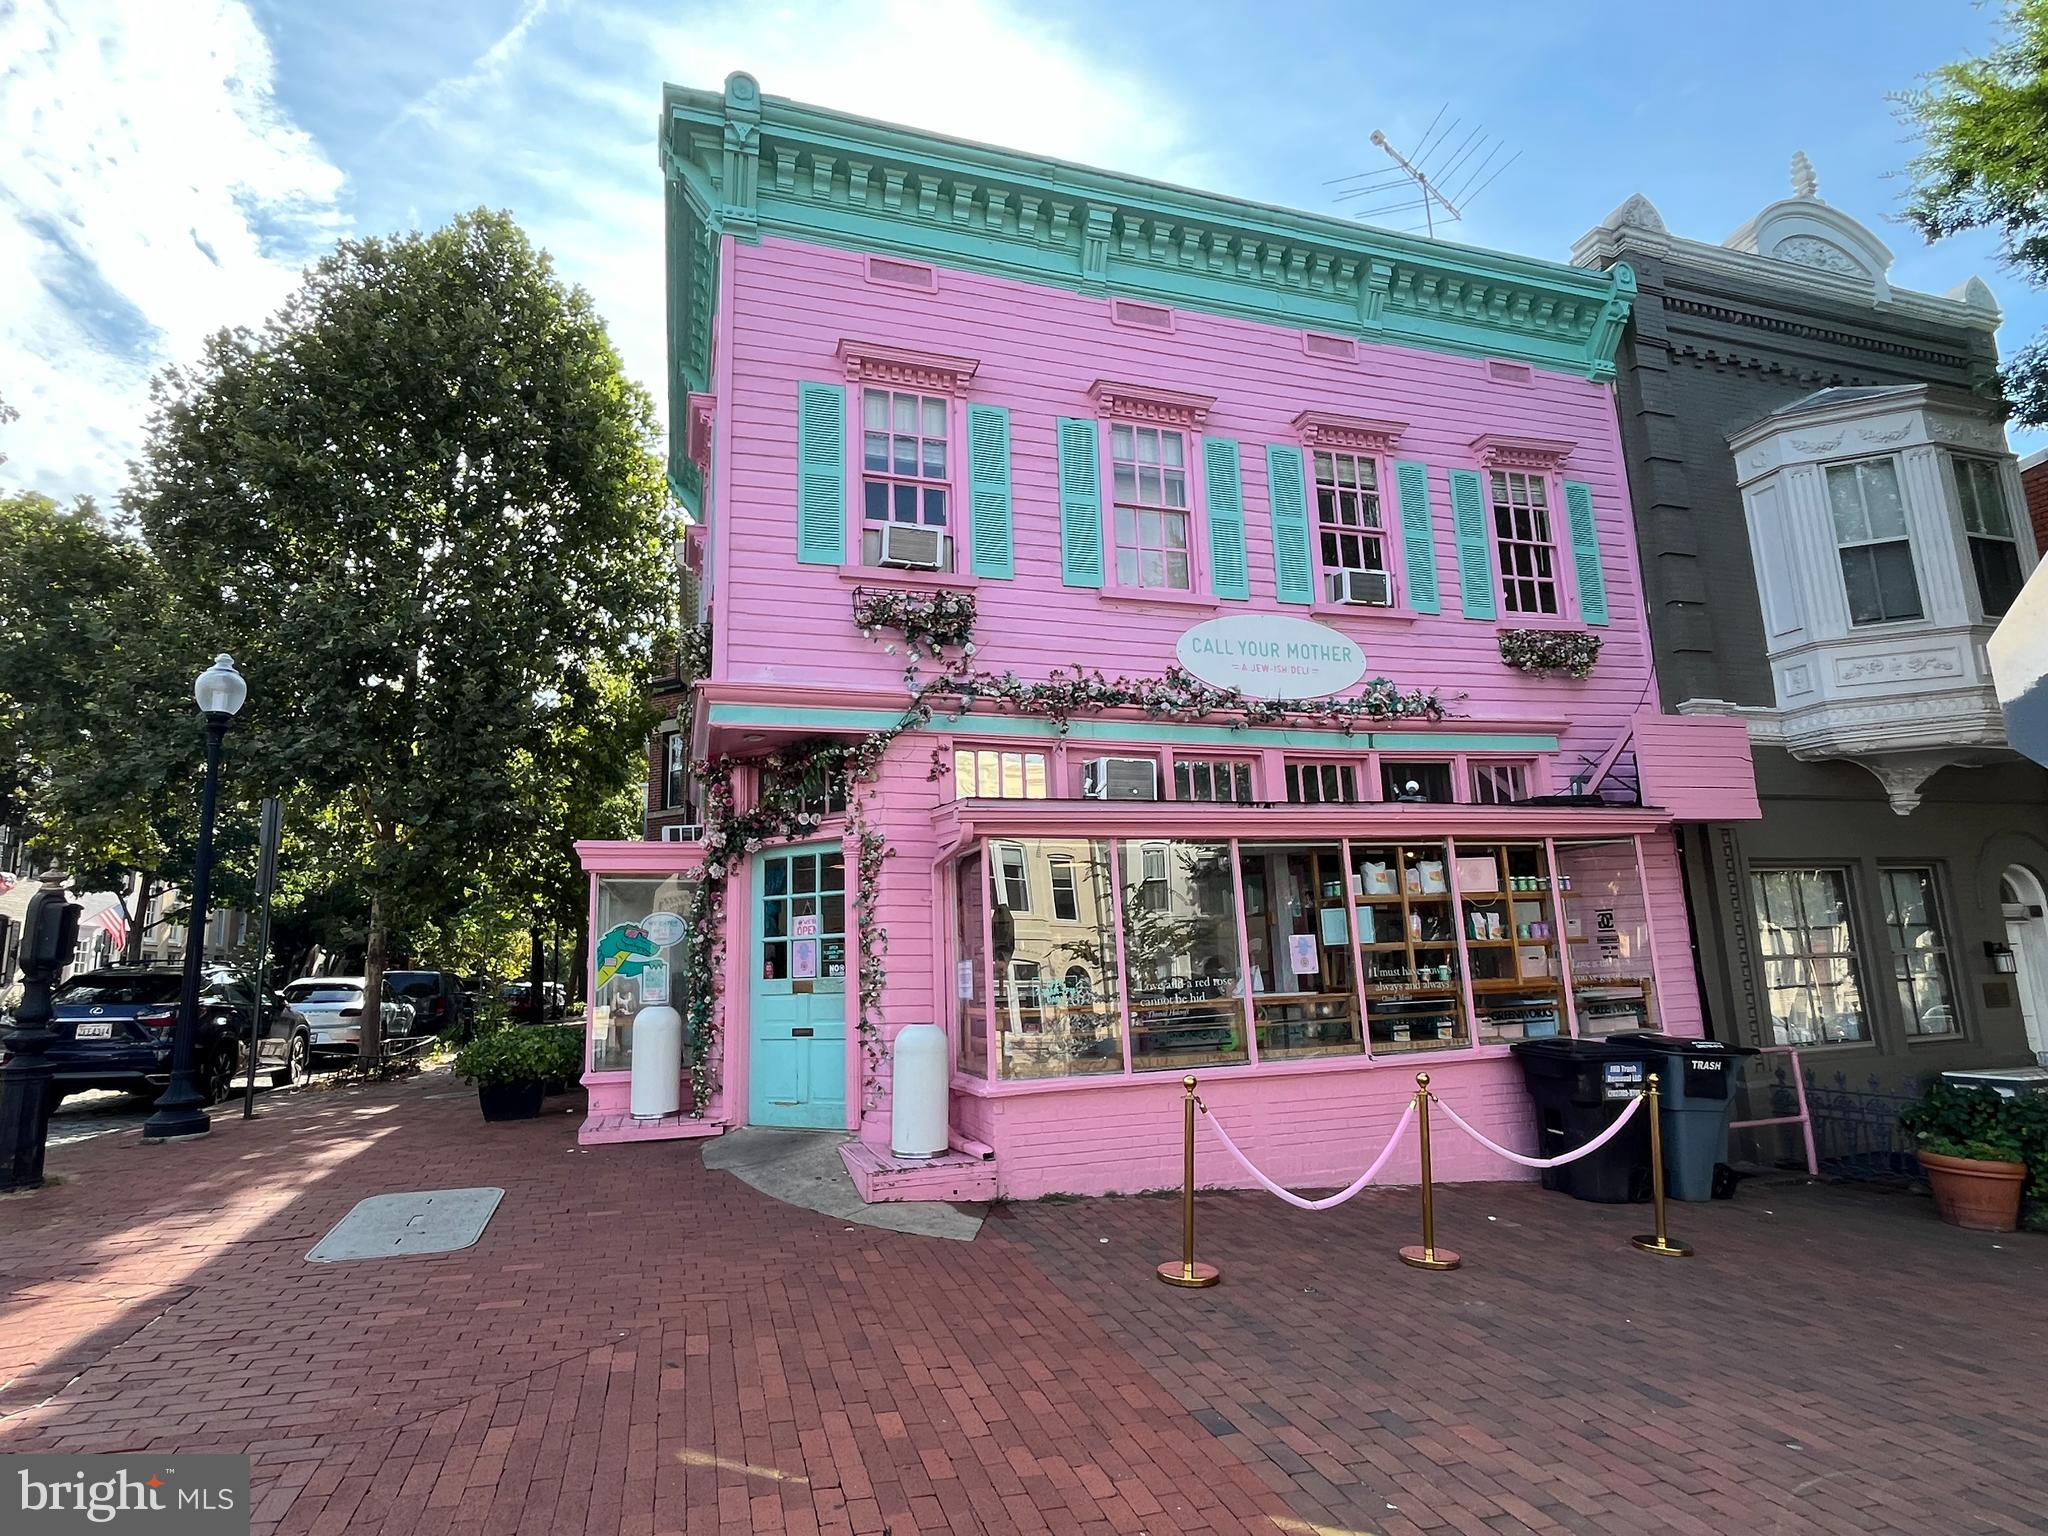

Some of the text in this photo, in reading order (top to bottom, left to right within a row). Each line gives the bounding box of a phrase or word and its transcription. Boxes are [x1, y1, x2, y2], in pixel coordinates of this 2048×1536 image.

[1192, 638, 1352, 662] CALL YOUR MOTHER
[1241, 663, 1310, 675] A JEW-ISH DELI
[1380, 968, 1401, 977] must
[1194, 976, 1210, 988] red
[1213, 978, 1233, 987] rose
[1375, 979, 1450, 993] always and always
[1140, 996, 1173, 1007] cannot
[1175, 993, 1188, 1005] be
[1491, 1007, 1554, 1020] GREENWORKS
[1691, 1060, 1722, 1070] TRASH
